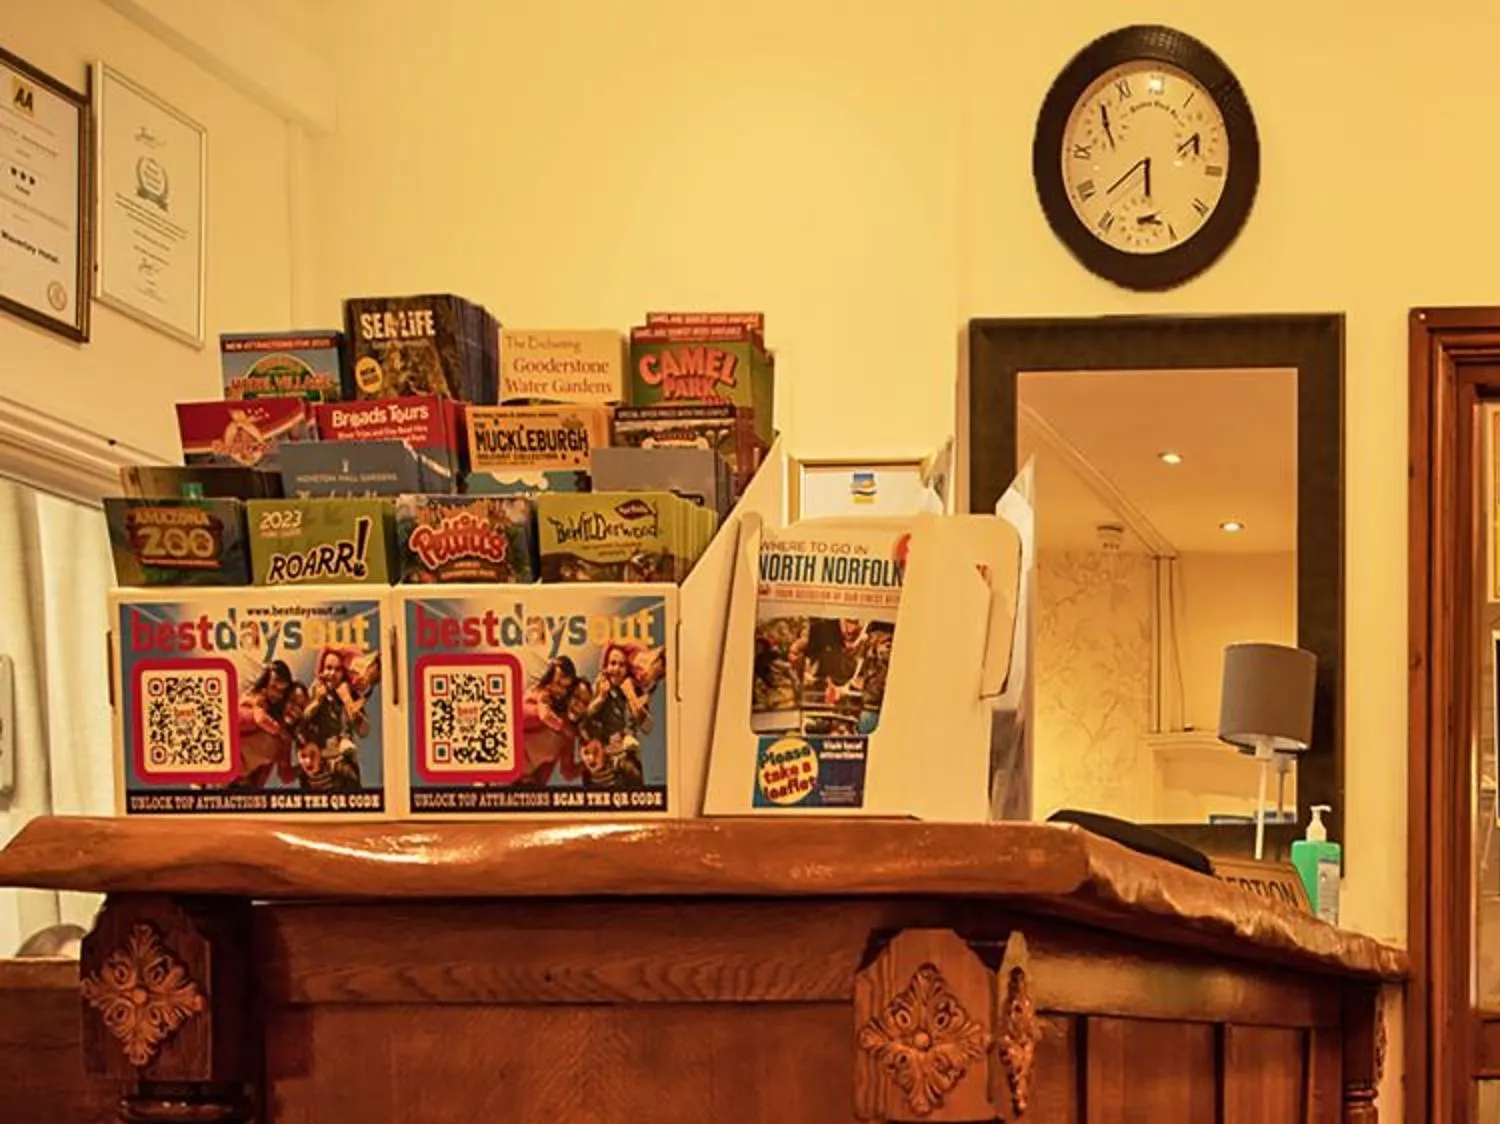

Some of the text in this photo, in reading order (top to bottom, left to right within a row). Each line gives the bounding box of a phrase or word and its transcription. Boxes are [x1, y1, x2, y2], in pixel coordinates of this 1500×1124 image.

[14, 87, 34, 112] AA
[360, 312, 398, 339] SEA
[506, 335, 526, 350] The
[513, 357, 609, 374] Gooderstone
[639, 347, 738, 386] CAMEL
[505, 377, 612, 393] Water Gardens
[663, 376, 717, 400] PARK
[331, 404, 429, 429] Broads Tours
[474, 428, 589, 452] MUCKLEBURGH
[135, 510, 211, 526] AMAZONA
[260, 510, 304, 529] 2023
[138, 527, 215, 558] ZOO
[267, 516, 372, 583] ROARR!
[760, 540, 806, 552] WHERE
[810, 541, 828, 552] TO
[831, 543, 851, 554] GO
[759, 553, 816, 583] NORTH
[416, 602, 655, 657] bestdaysout
[760, 745, 811, 769] Please
[764, 761, 811, 785] take a
[414, 792, 663, 808] UNLOCK TOP ATTRACTIONS SCAN THE QR CODE
[764, 776, 815, 800] leaflet
[195, 795, 268, 809] ATTRACTIONS
[270, 795, 302, 809] SCAN
[304, 795, 329, 808] THE
[330, 795, 347, 810] QR
[348, 794, 381, 808] CODE
